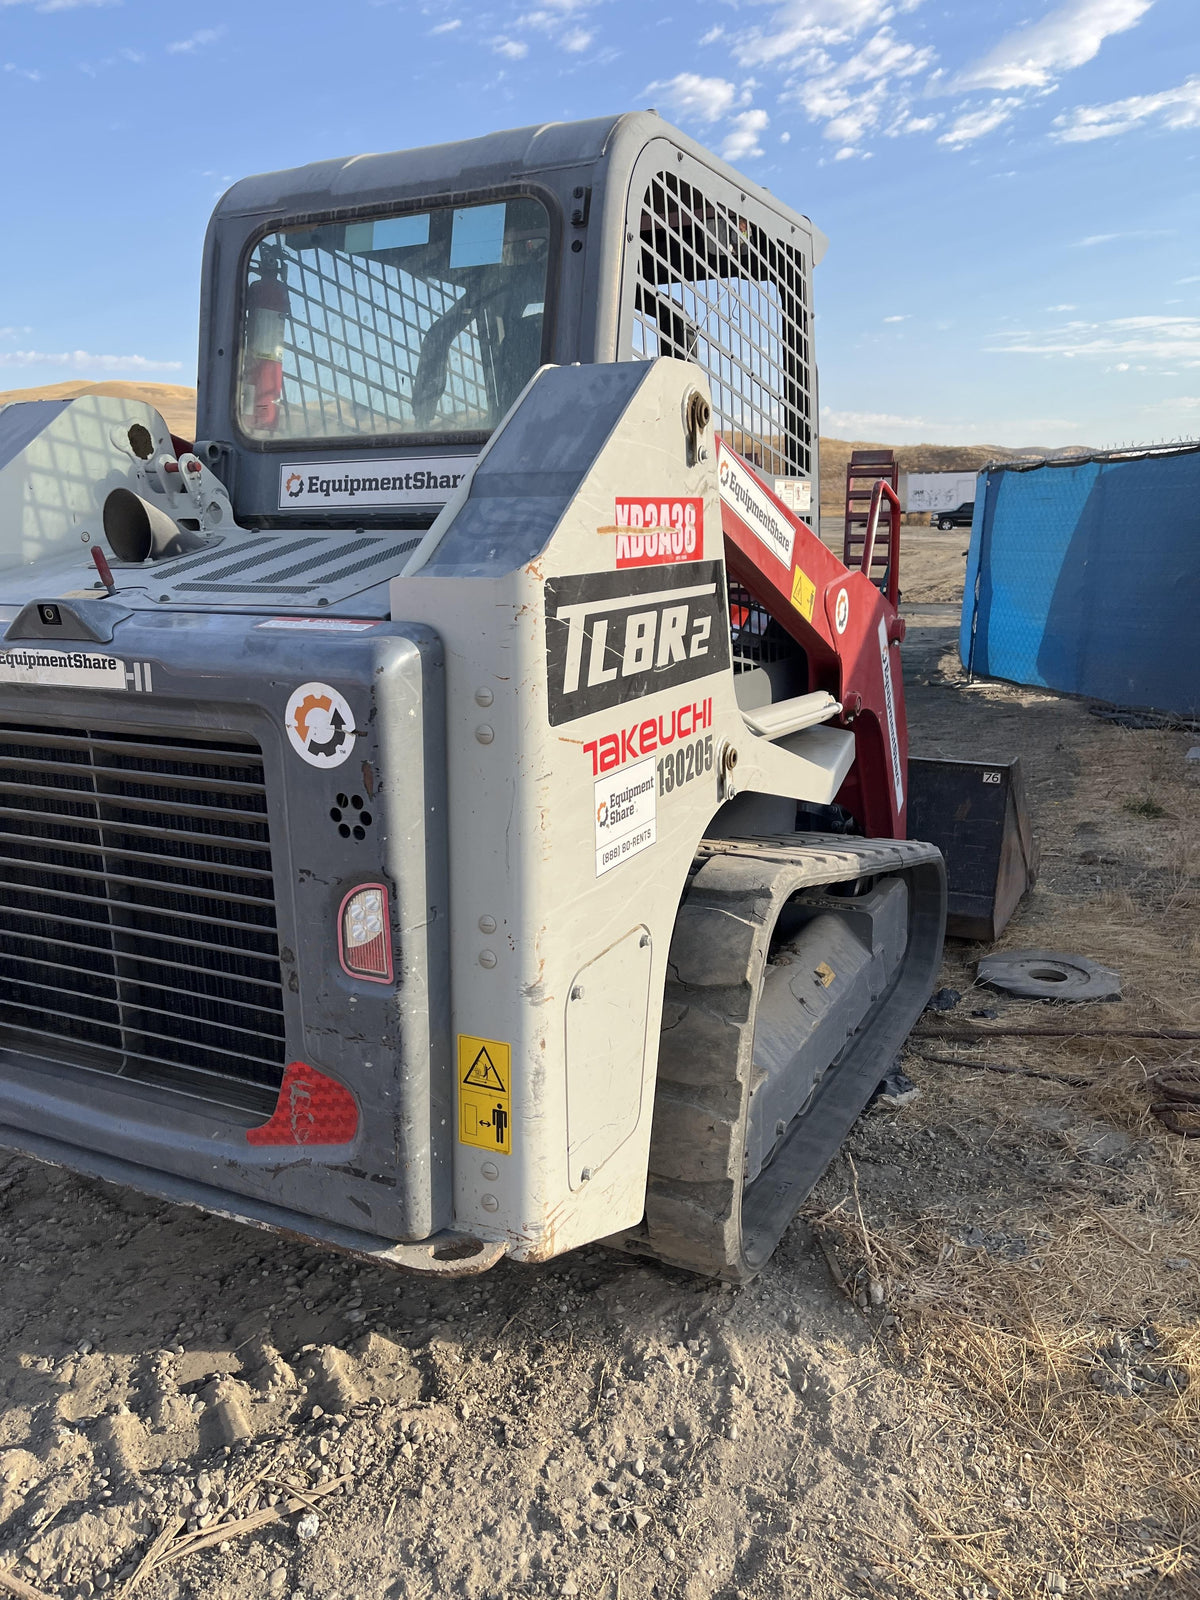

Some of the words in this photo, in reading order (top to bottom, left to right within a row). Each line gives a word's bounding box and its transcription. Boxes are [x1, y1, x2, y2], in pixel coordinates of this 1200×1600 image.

[307, 471, 466, 497] EquipmentShar
[729, 471, 790, 552] EquipmentShare
[657, 734, 713, 797] 130205
[985, 773, 999, 783] 76
[609, 776, 654, 809] Equipment
[609, 804, 635, 826] Share
[602, 845, 620, 866] (888)
